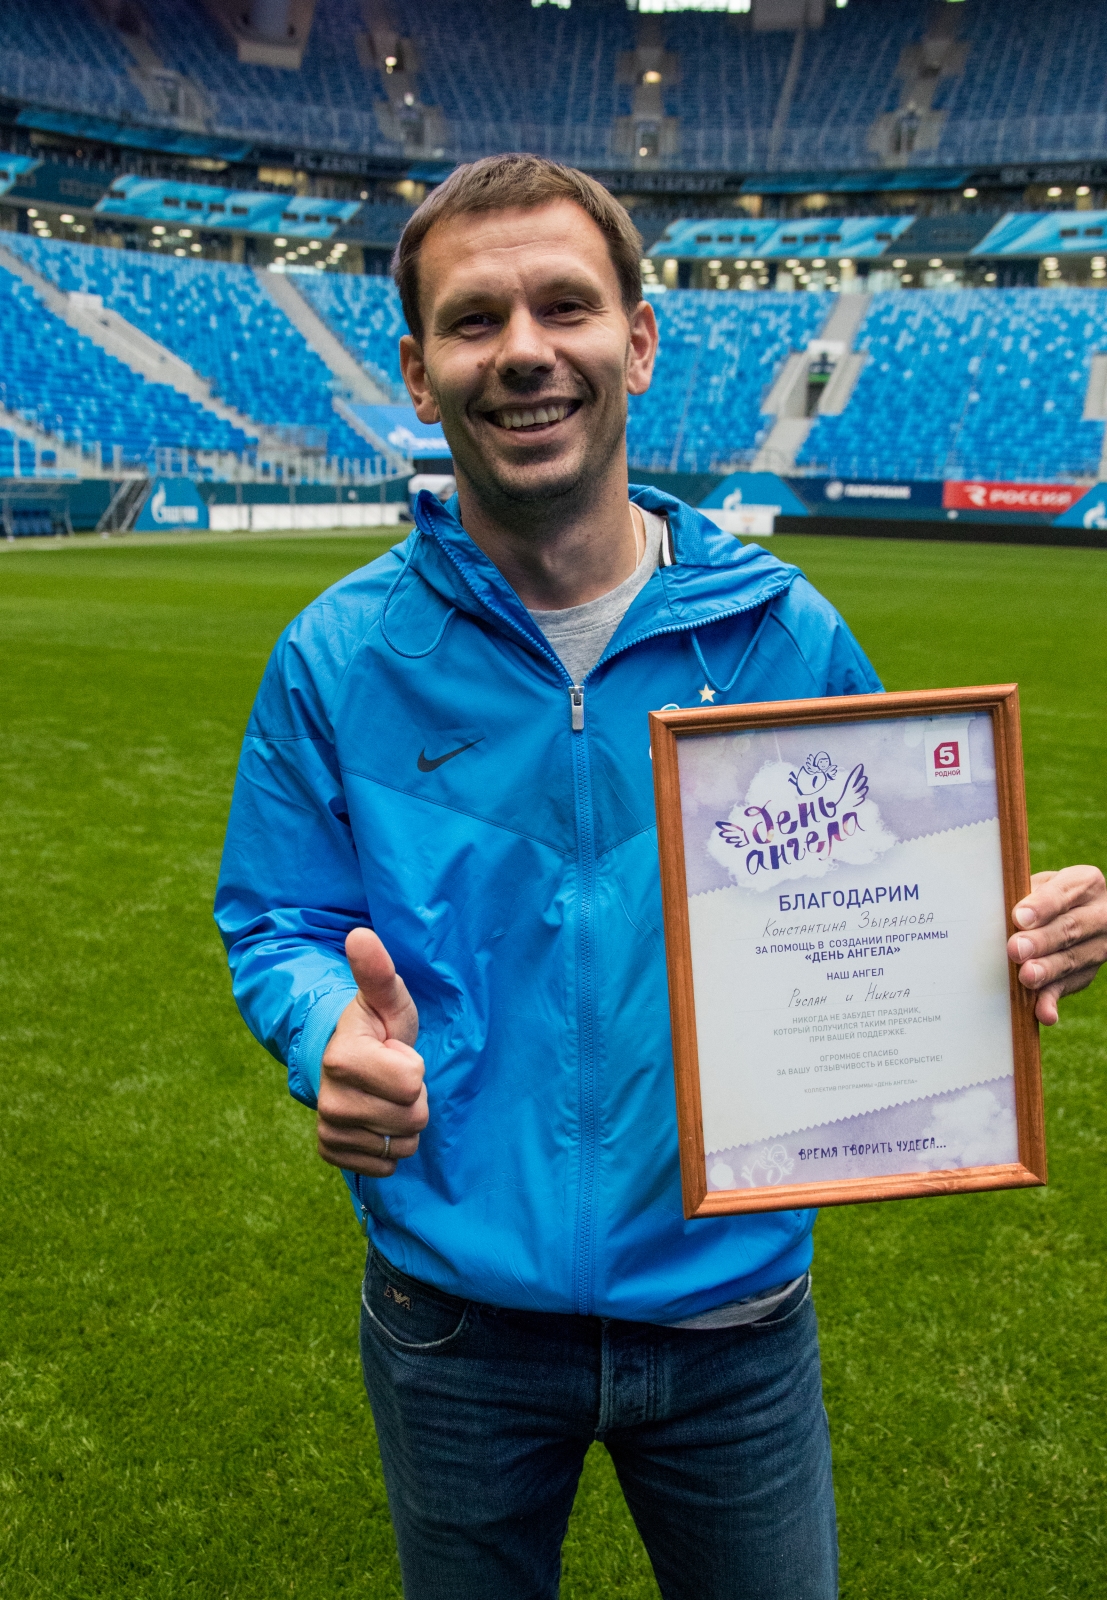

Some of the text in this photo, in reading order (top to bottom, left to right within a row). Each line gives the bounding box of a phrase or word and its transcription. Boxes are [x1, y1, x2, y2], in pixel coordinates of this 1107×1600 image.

[939, 746, 955, 765] 5
[934, 768, 961, 778] РОДНОЙ
[778, 883, 920, 912] БЛАГОДАРИМ
[762, 910, 934, 938] Константина Зырянова
[755, 929, 949, 955] ЗА ПОМОЩЬ В СОЗДАНИИ ПРОГРАММЫ
[804, 944, 901, 964] «ДЕНЬ АНГЕЛА»
[826, 967, 884, 981] НАШ АНГЕЛ
[773, 1014, 941, 1036] КОТОРЫЙ ПОЛУЧИЛСЯ ТАКИМ ПРЕКРАСНЫМ
[792, 1014, 829, 1025] НИКОГДА
[829, 1013, 840, 1022] НЕ
[841, 1010, 876, 1021] ЗАБУДЕТ
[809, 1034, 825, 1043] ПРИ
[826, 1031, 855, 1043] ВАШЕЙ
[776, 1054, 943, 1076] ЗА ВАШУ ОТЗЫВЧИВОСТЬ И БЕСКОРЫСТИЕ!
[819, 1048, 899, 1063] ОГРОМНОЕ СПАСИБО
[797, 1146, 838, 1161] ВРЕМЯ
[842, 1141, 893, 1157] ТВОРИТЬ
